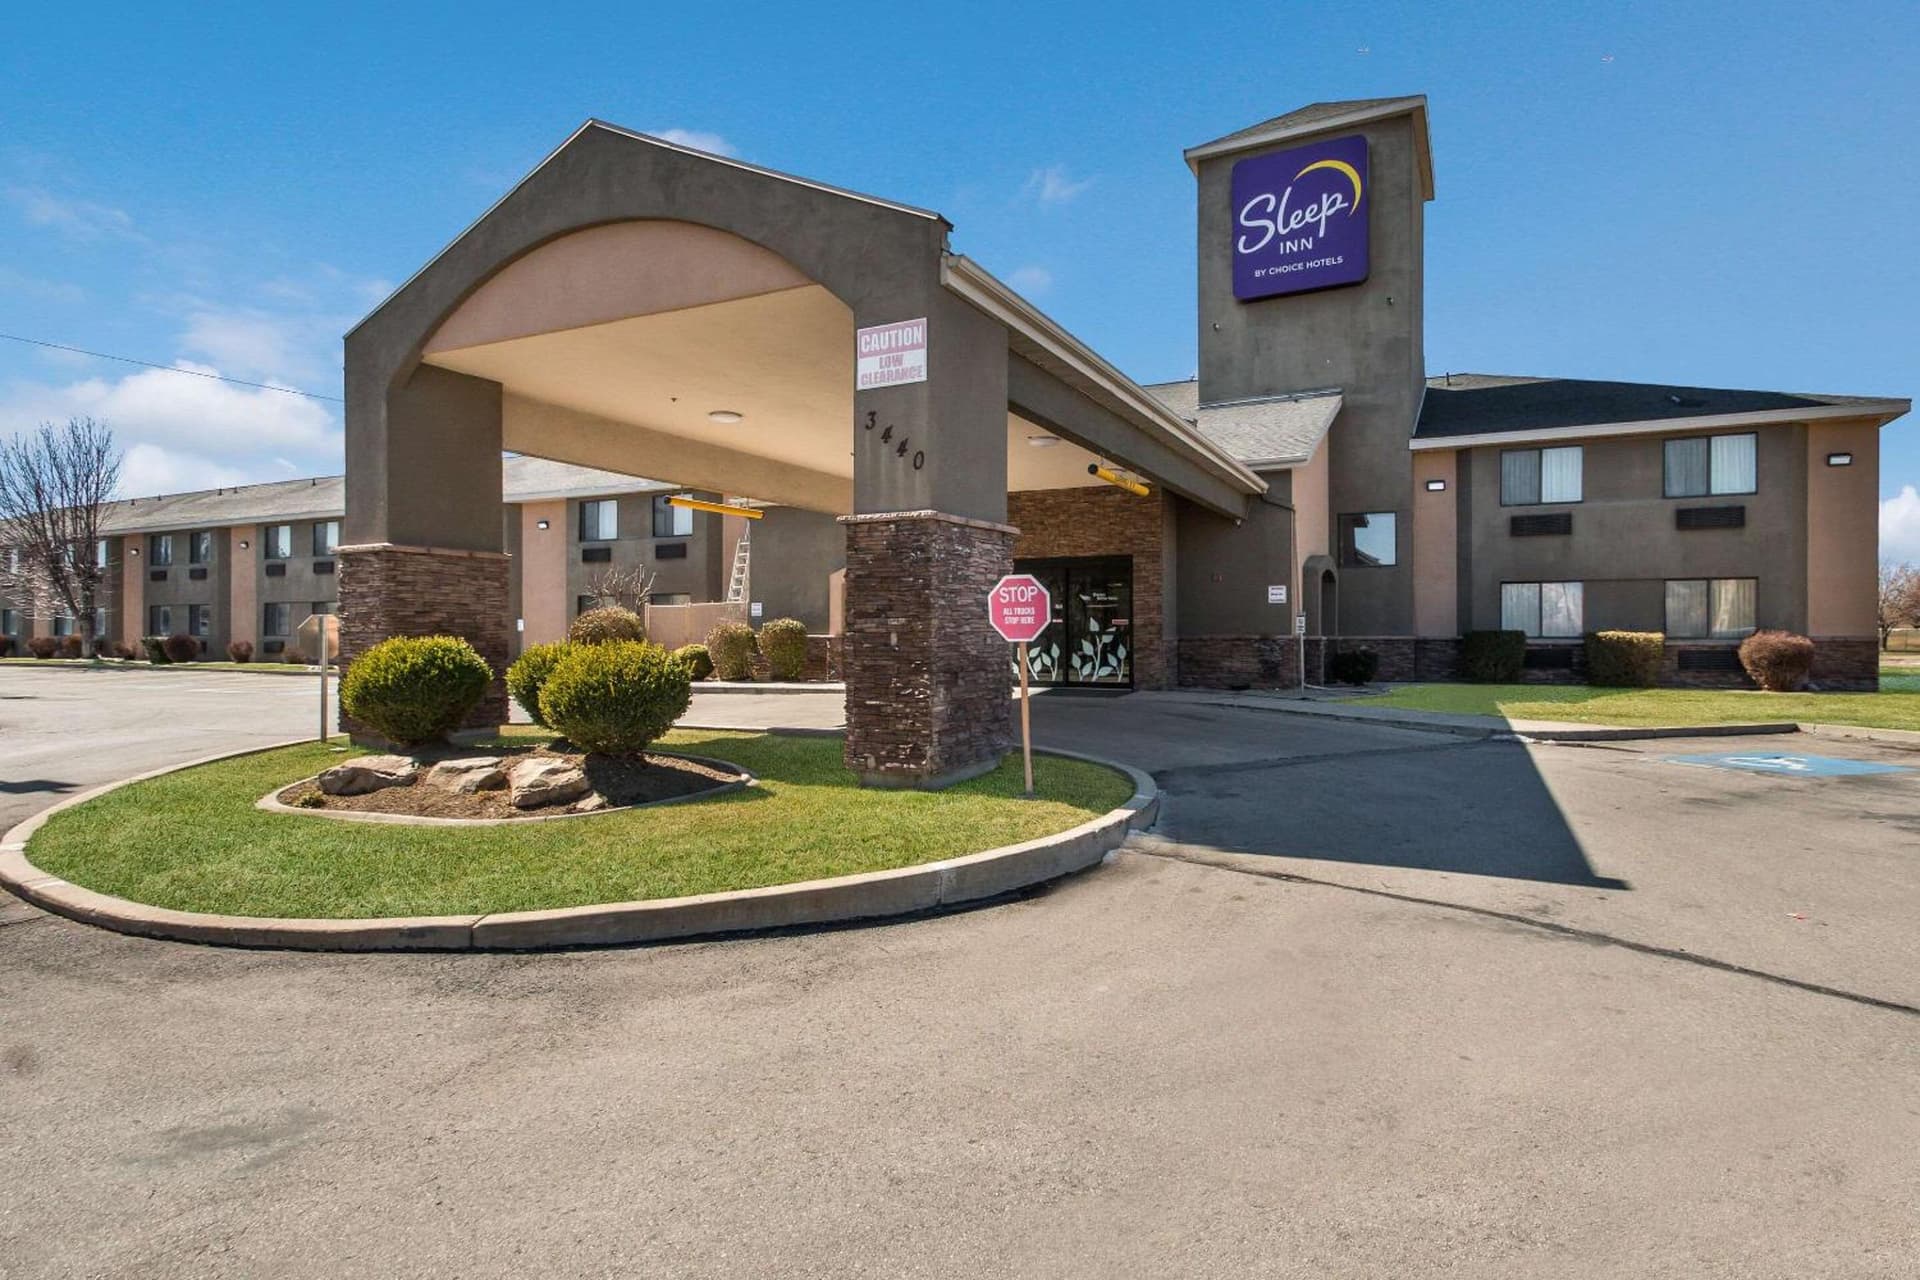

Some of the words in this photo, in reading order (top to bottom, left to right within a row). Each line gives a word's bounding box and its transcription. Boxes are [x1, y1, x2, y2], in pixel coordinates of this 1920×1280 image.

[1238, 186, 1349, 254] Sleep
[1280, 236, 1313, 255] INN
[1254, 268, 1267, 277] BY
[1269, 262, 1304, 275] CHOICE
[1306, 255, 1344, 268] HOTELS
[861, 324, 922, 353] CAUTION
[879, 353, 904, 369] LOW
[860, 365, 923, 387] CLEARANCE
[999, 585, 1038, 604] STOP
[1003, 607, 1013, 615] ALL
[1014, 607, 1036, 615] TRUCKS
[1004, 616, 1020, 624] STOP
[1020, 616, 1036, 624] HERE
